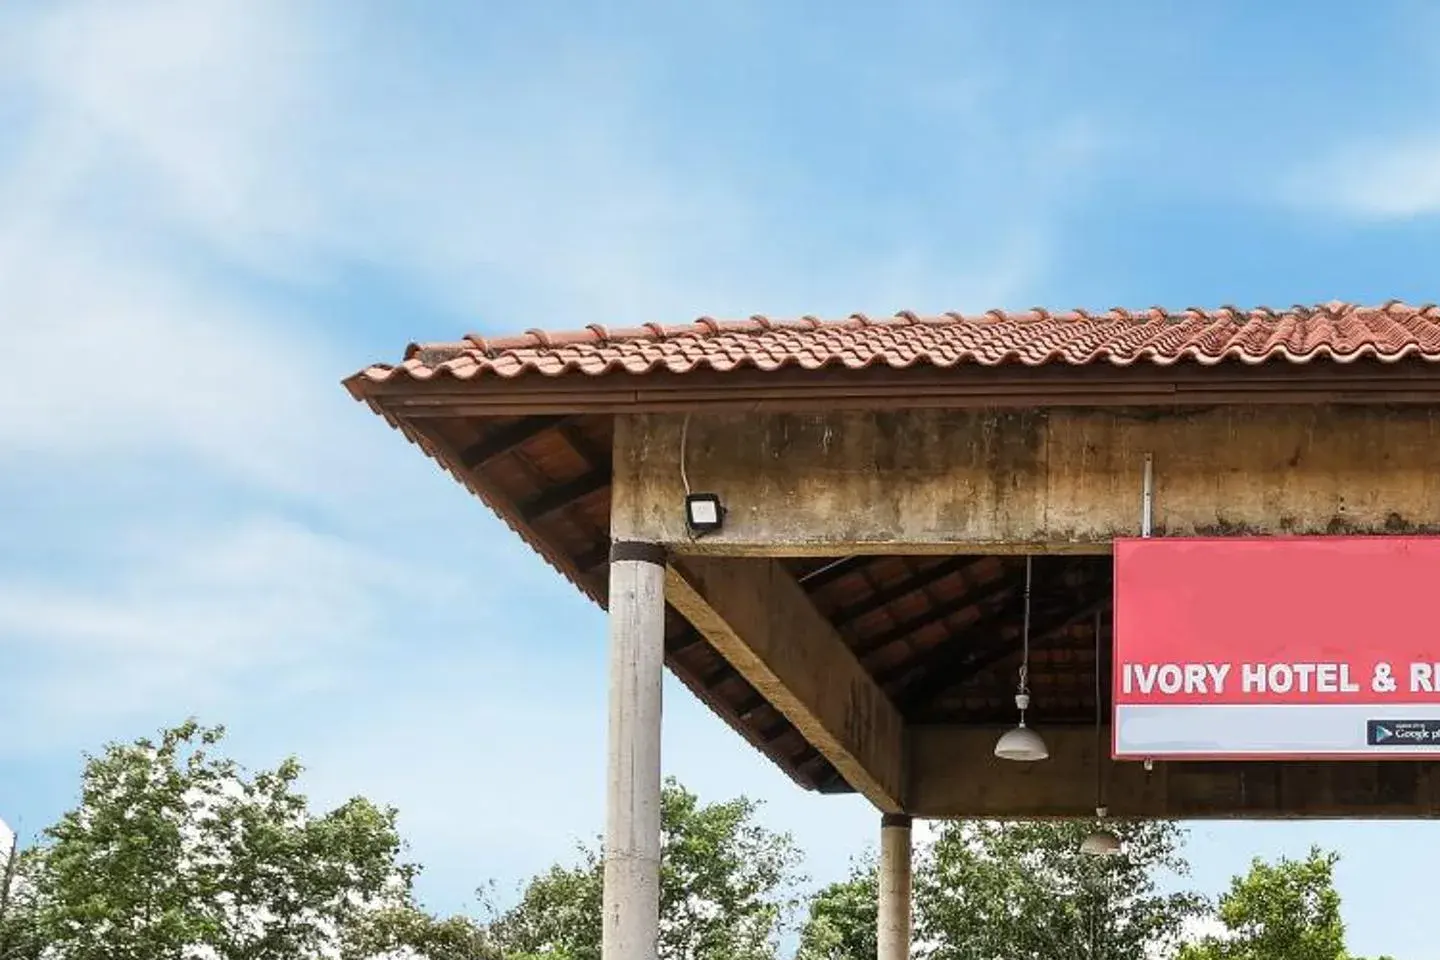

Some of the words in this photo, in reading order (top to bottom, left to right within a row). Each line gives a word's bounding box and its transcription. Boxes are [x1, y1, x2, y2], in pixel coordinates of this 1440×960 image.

[1122, 663, 1231, 695] IVORY
[1242, 662, 1360, 693] HOTEL
[1371, 662, 1397, 693] &
[1394, 729, 1430, 741] Google
